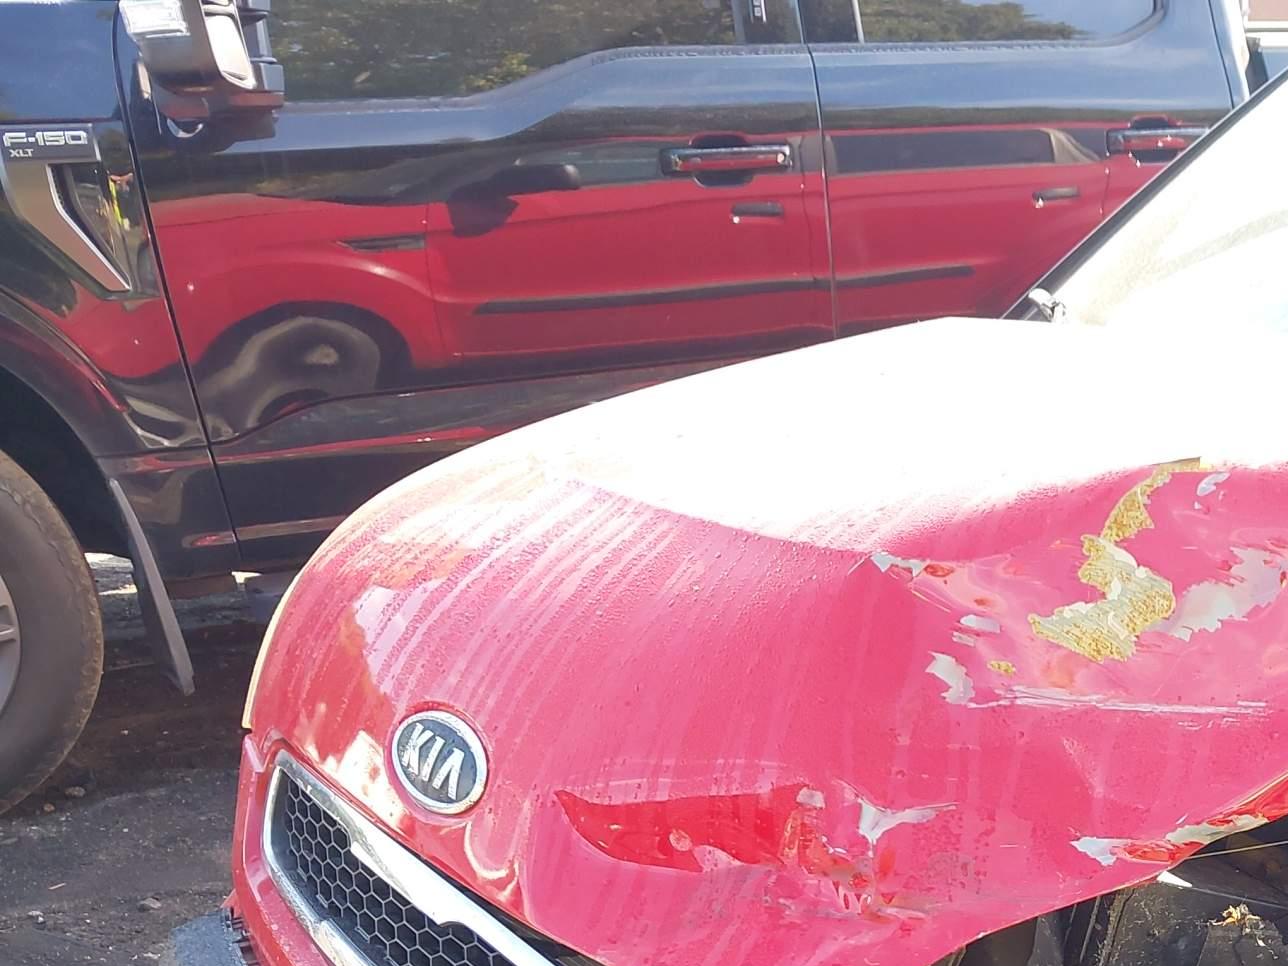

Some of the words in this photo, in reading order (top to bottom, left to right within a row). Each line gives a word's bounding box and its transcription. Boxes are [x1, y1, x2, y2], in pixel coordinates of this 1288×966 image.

[3, 130, 88, 147] F-150
[9, 148, 34, 158] XLT
[400, 721, 466, 801] KIA
